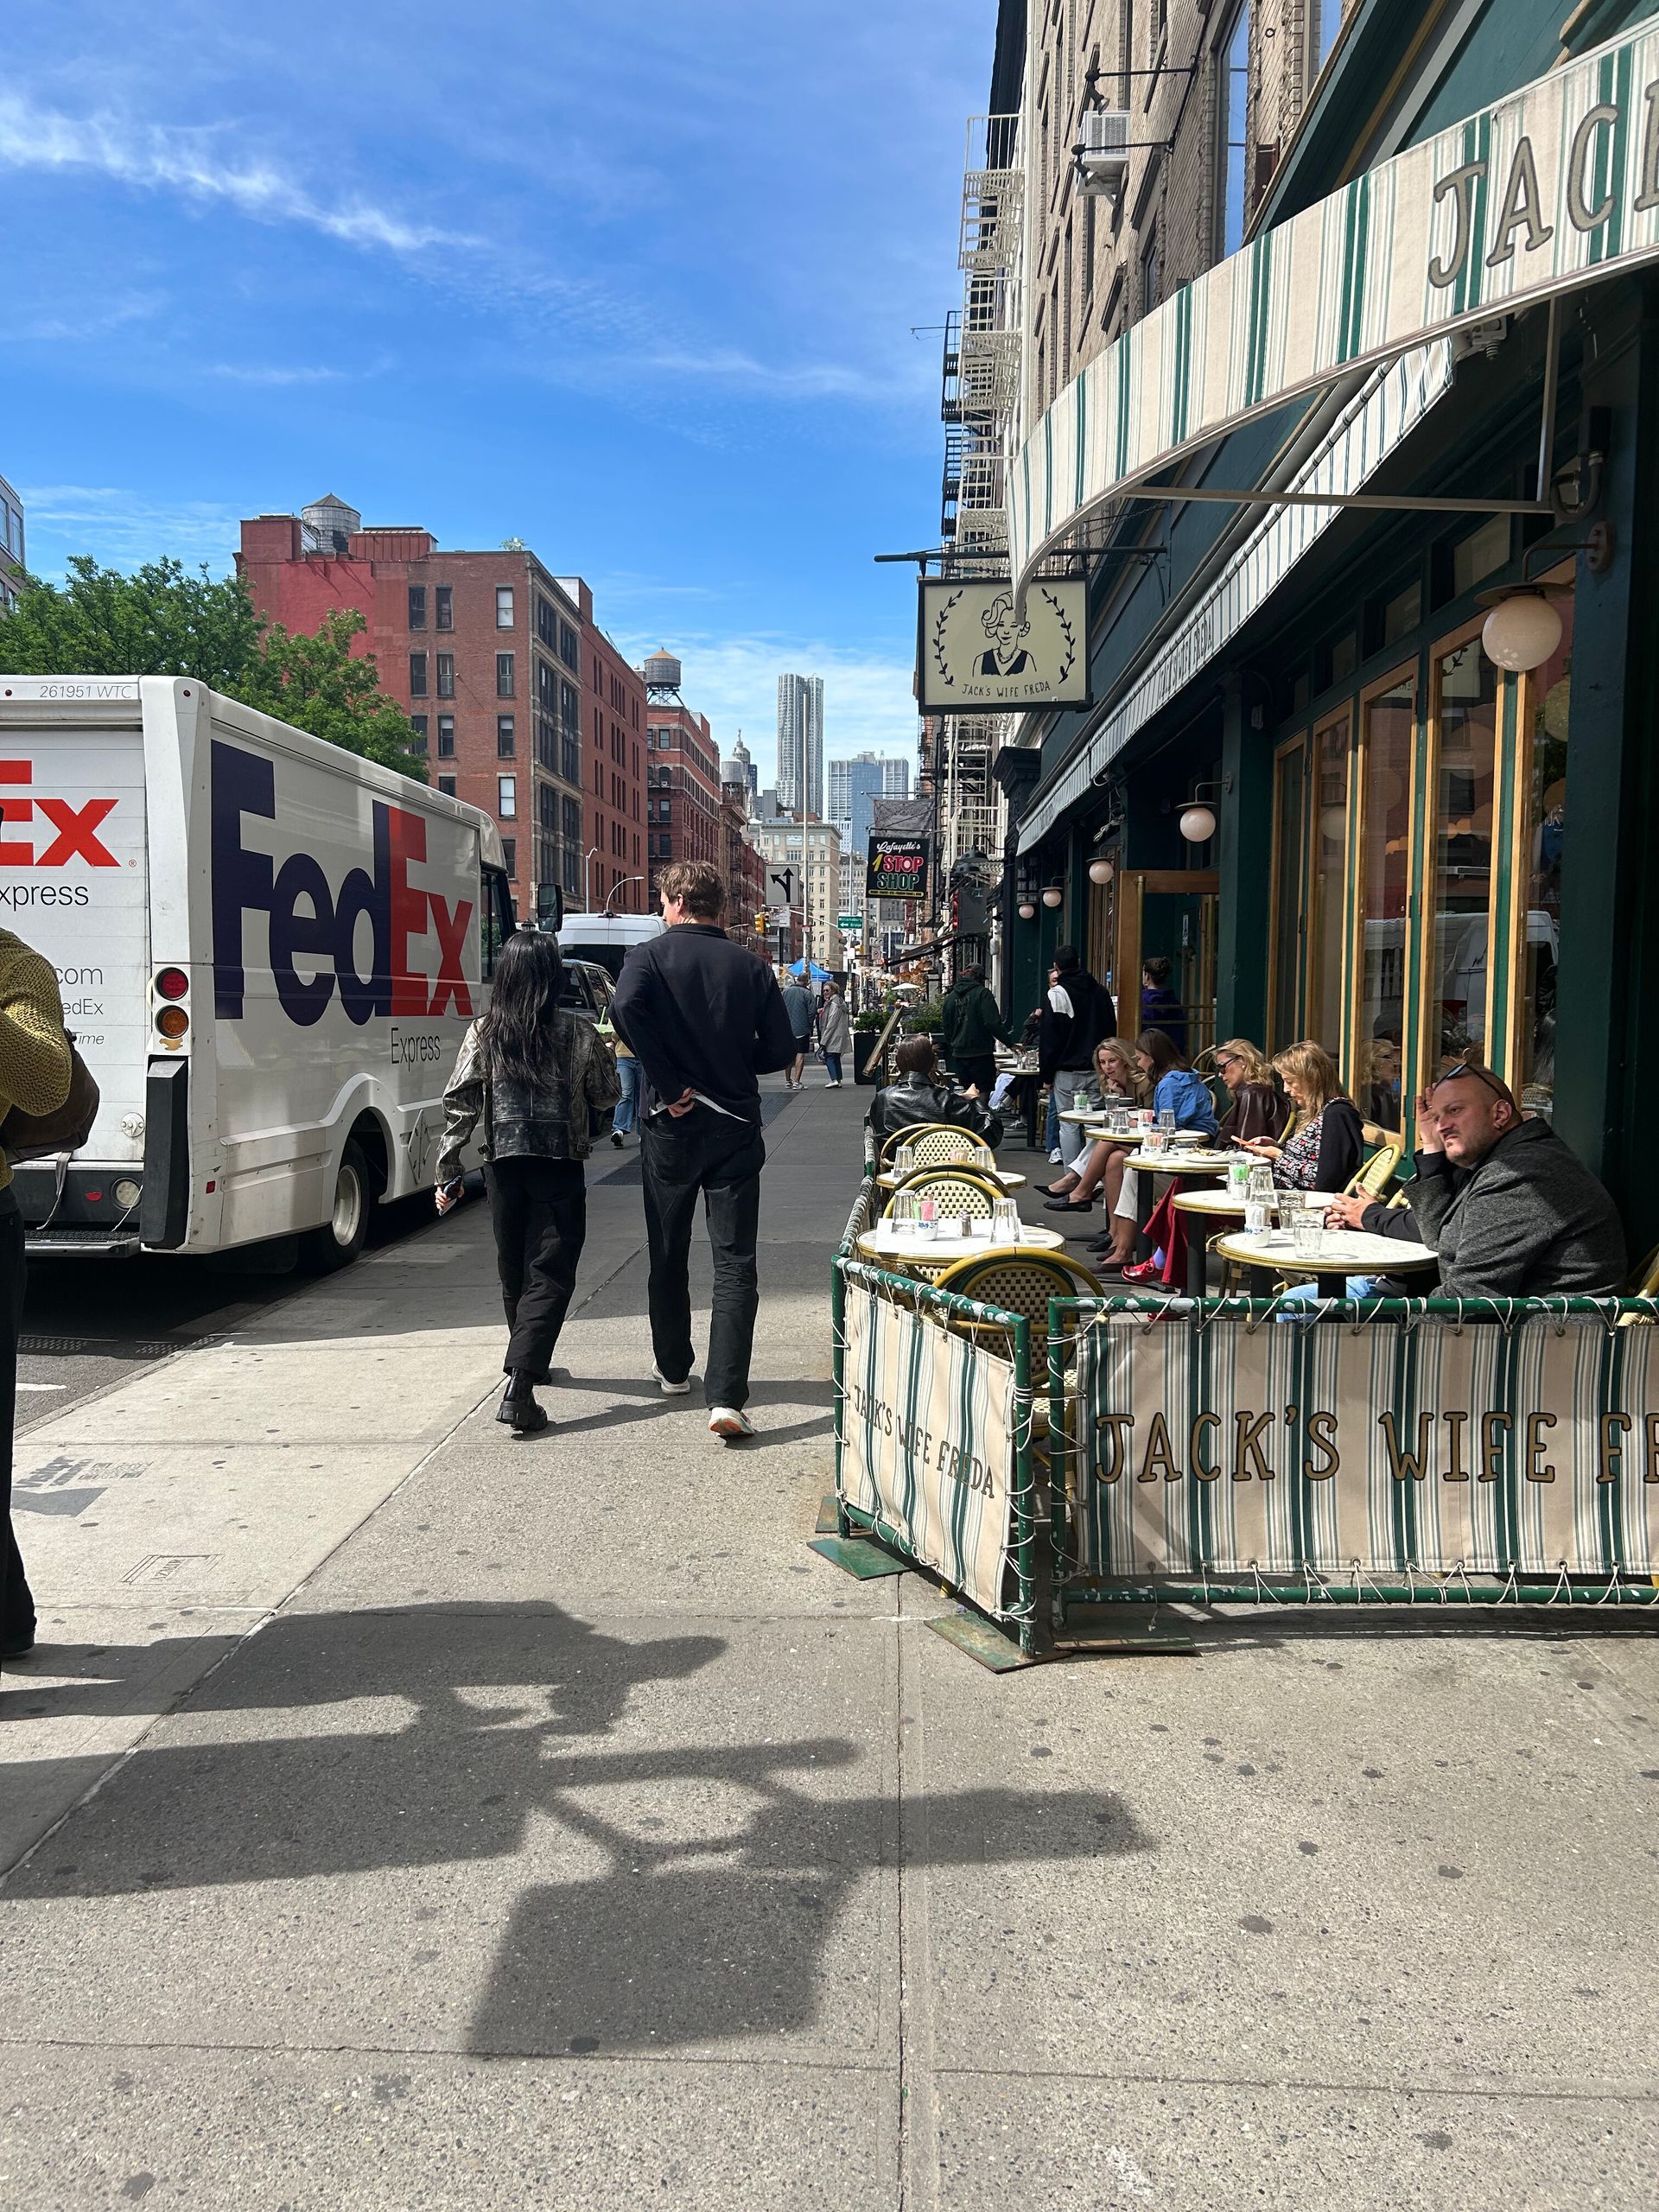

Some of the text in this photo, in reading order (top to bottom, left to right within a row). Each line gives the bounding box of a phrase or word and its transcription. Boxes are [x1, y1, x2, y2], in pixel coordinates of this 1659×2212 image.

[40, 685, 132, 699] 261951 WTC
[962, 680, 1051, 697] JACK'S WIFE FREDA
[872, 853, 924, 873] 1 STOP
[211, 739, 474, 1027] FedEx
[877, 872, 919, 890] SHOP
[391, 1027, 441, 1073] Express
[854, 1384, 995, 1499] JACK'S WIFE FREDA
[1095, 1404, 1340, 1484] JACK'S
[1377, 1411, 1558, 1484] WIFE
